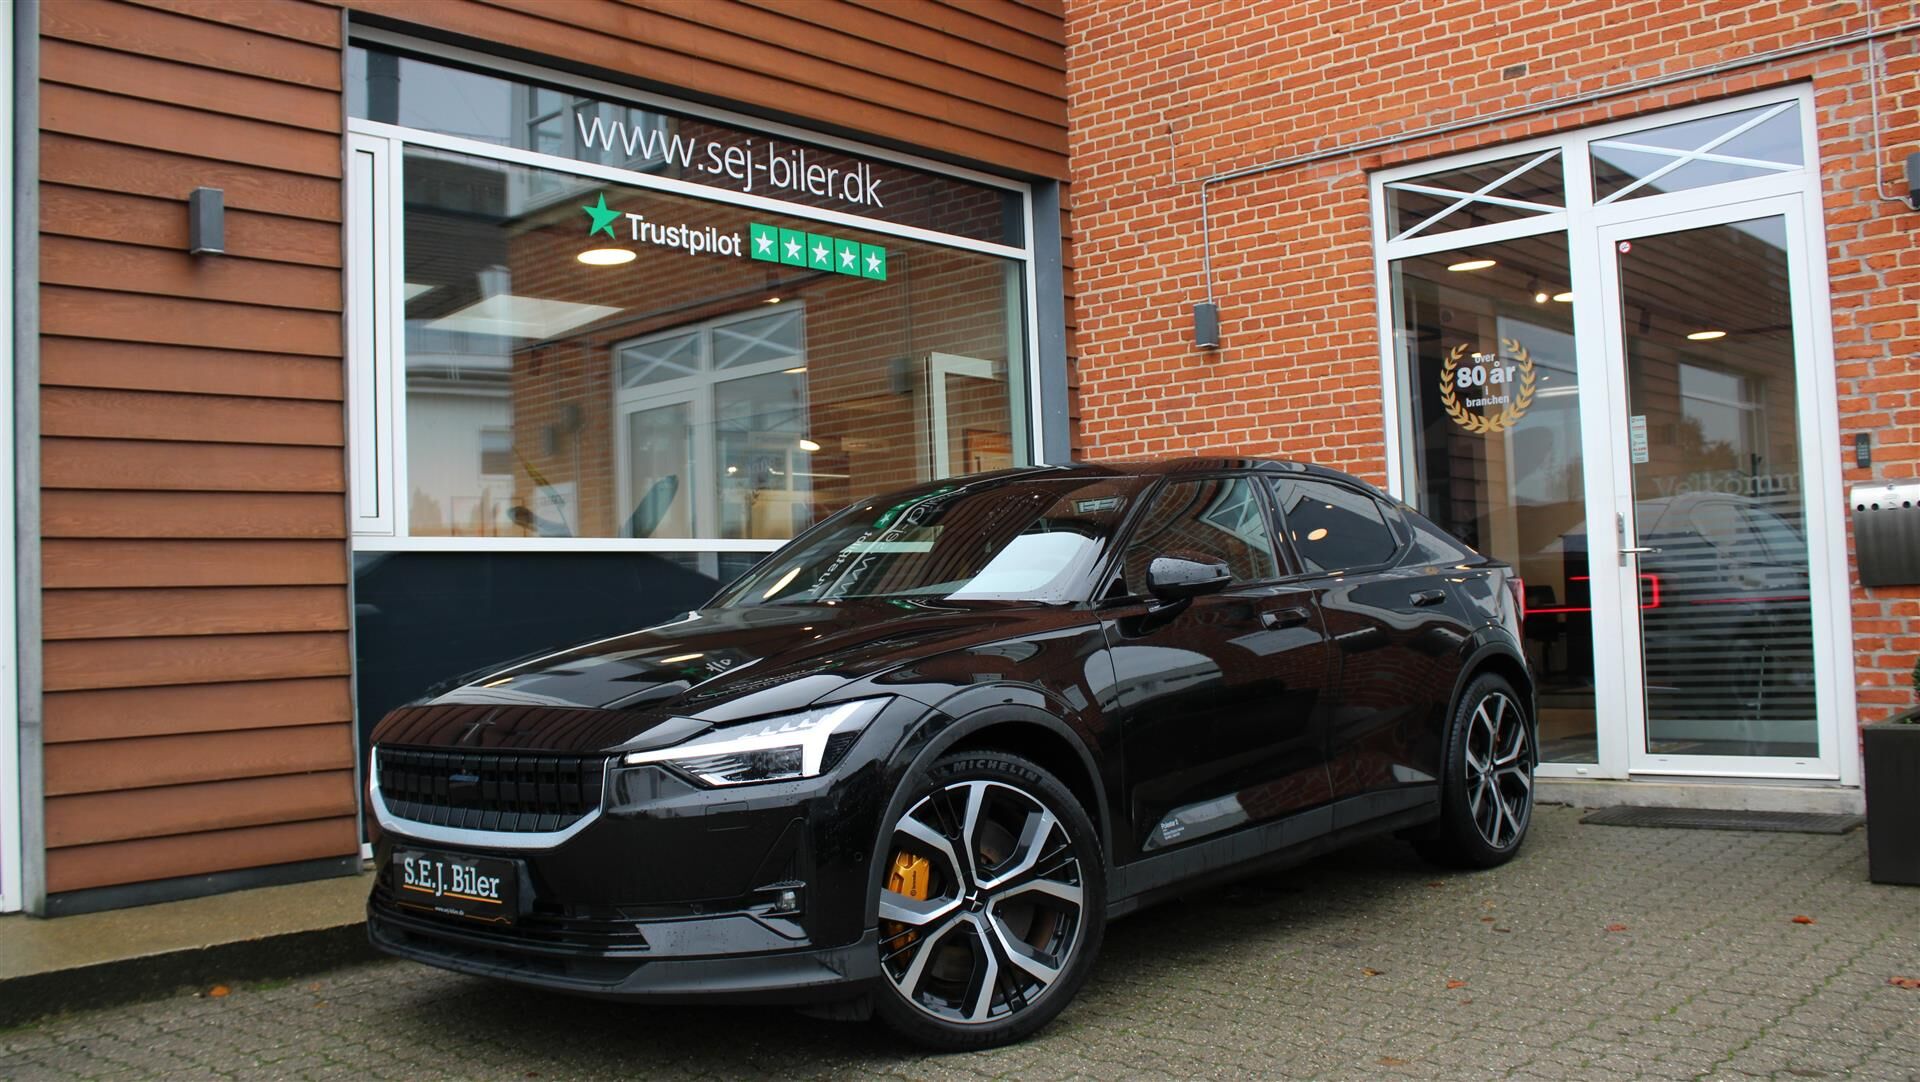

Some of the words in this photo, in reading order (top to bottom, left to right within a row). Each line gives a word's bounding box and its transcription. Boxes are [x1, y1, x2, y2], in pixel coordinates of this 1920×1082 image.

[577, 113, 884, 208] www.sej-biler.dk
[625, 213, 742, 257] Trustpilot
[1474, 353, 1496, 364] over
[1456, 366, 1487, 388] 80
[1489, 361, 1516, 384] år
[1466, 394, 1510, 408] branchen
[953, 759, 1039, 782] MICHELIN
[404, 857, 448, 897] S.E.J.
[451, 864, 500, 898] Biler
